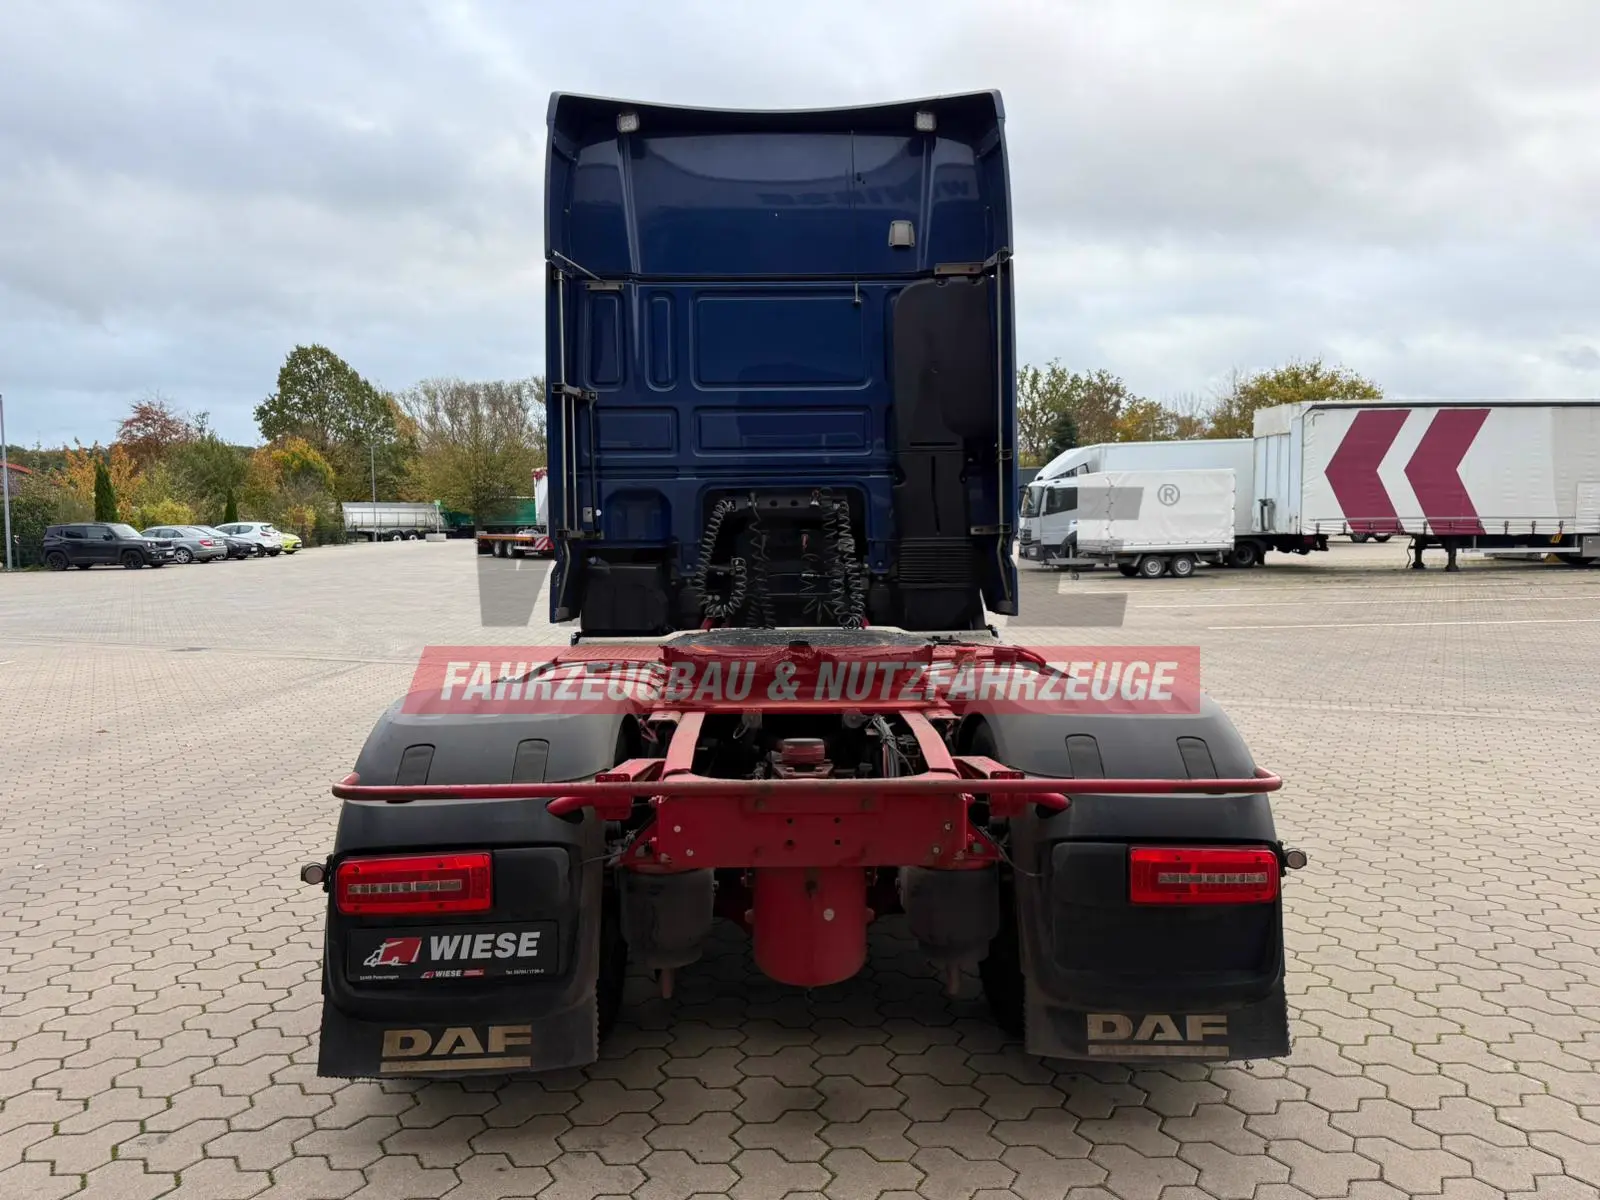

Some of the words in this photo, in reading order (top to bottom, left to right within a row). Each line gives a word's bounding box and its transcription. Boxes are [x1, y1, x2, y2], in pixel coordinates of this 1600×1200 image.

[429, 931, 541, 961] WIESE
[434, 969, 463, 977] WIESE
[381, 1024, 532, 1057] DAF
[1086, 1013, 1229, 1041] DAF
